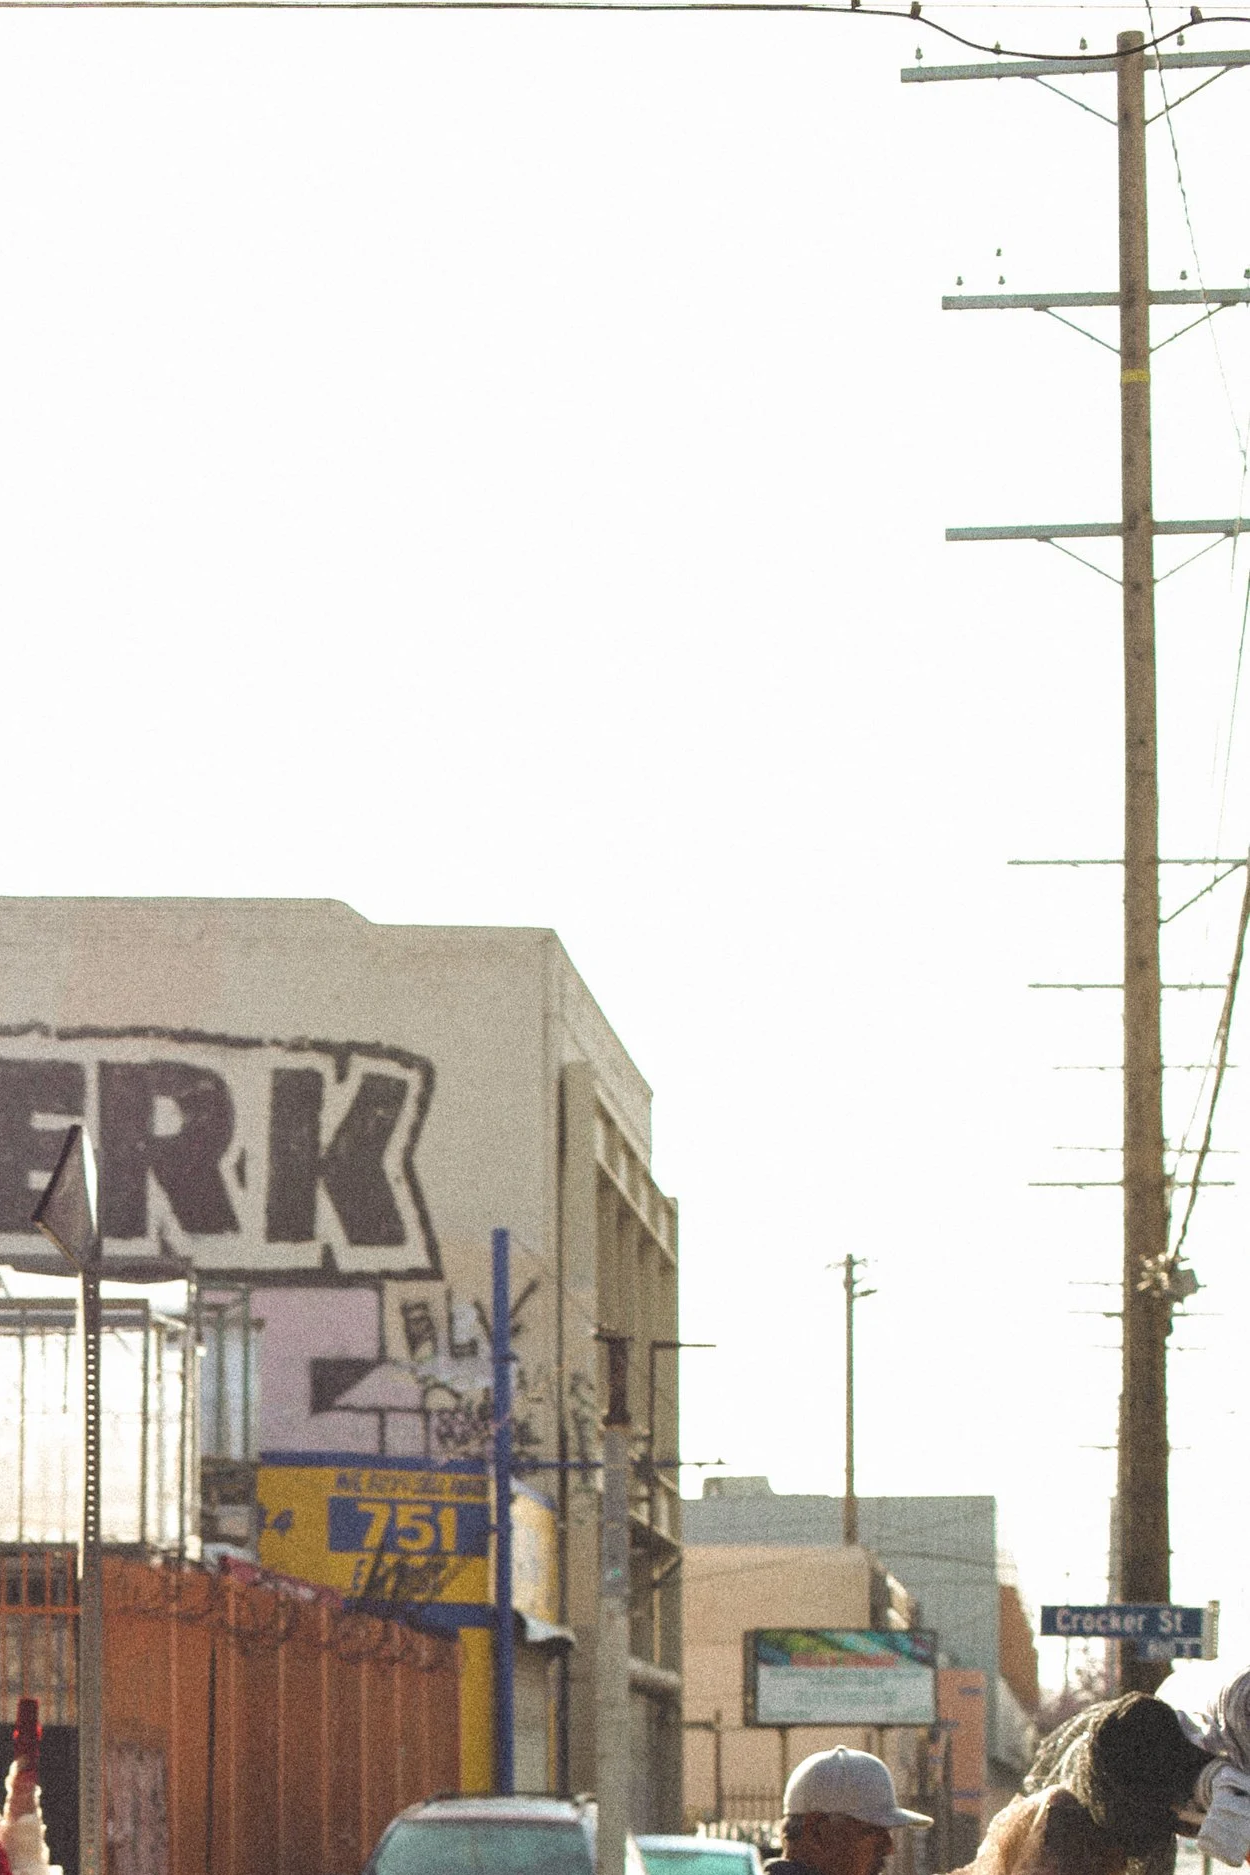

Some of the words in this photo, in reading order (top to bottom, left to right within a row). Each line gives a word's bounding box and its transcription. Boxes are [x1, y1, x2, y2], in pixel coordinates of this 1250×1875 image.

[356, 1501, 458, 1551] 751
[1055, 1607, 1147, 1634] Crocker
[1158, 1609, 1183, 1634] St
